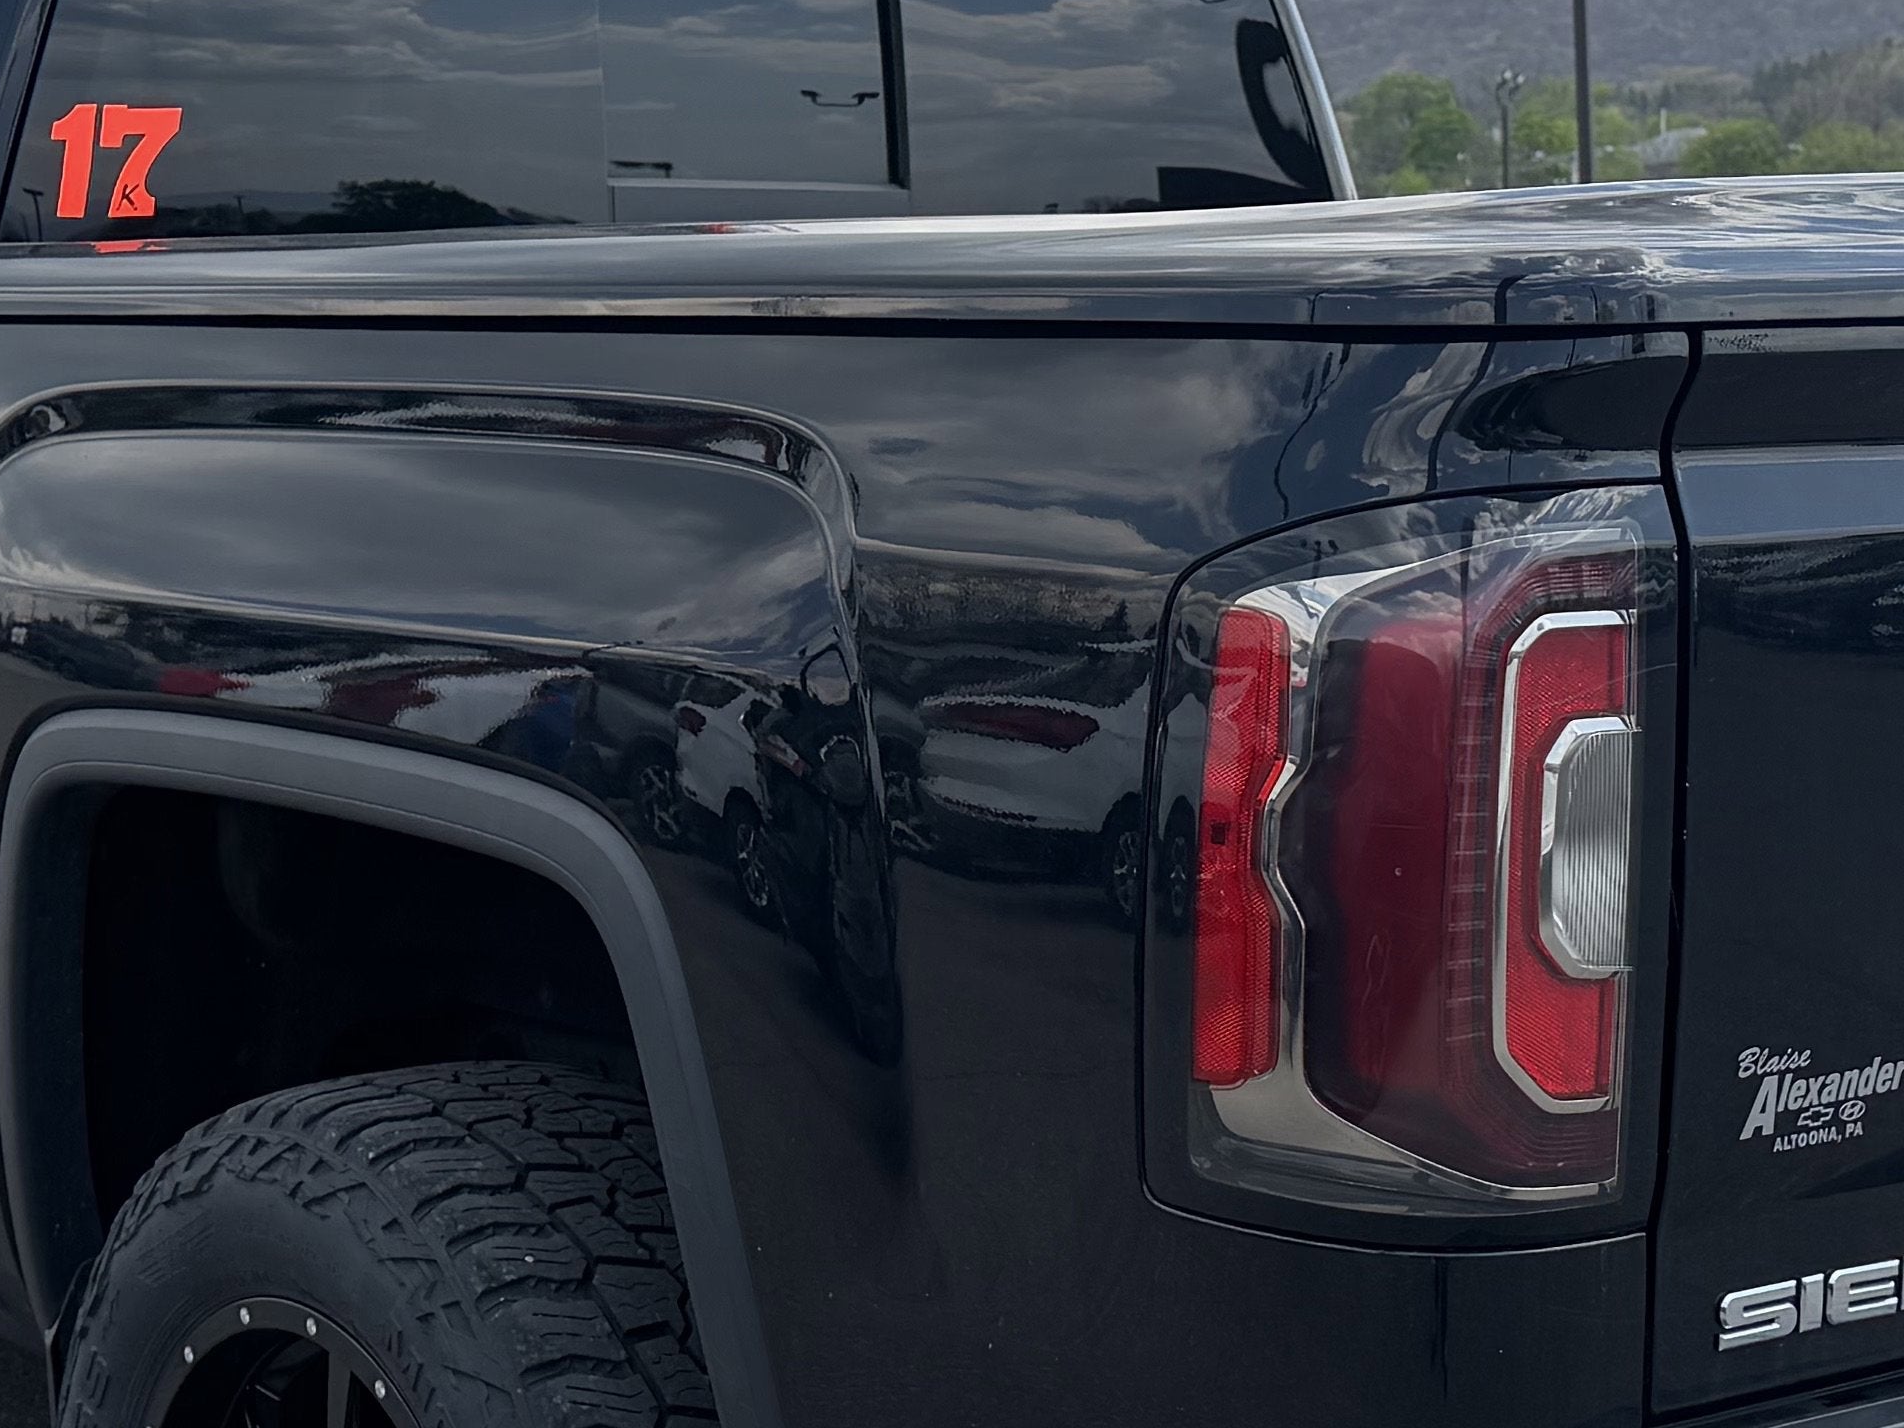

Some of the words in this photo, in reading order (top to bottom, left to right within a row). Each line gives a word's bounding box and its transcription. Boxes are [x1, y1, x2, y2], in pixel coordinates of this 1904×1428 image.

[50, 103, 182, 219] 17
[1737, 1046, 1812, 1080] Blaise
[1772, 1126, 1843, 1153] ALTOONA,
[1845, 1121, 1864, 1138] PA
